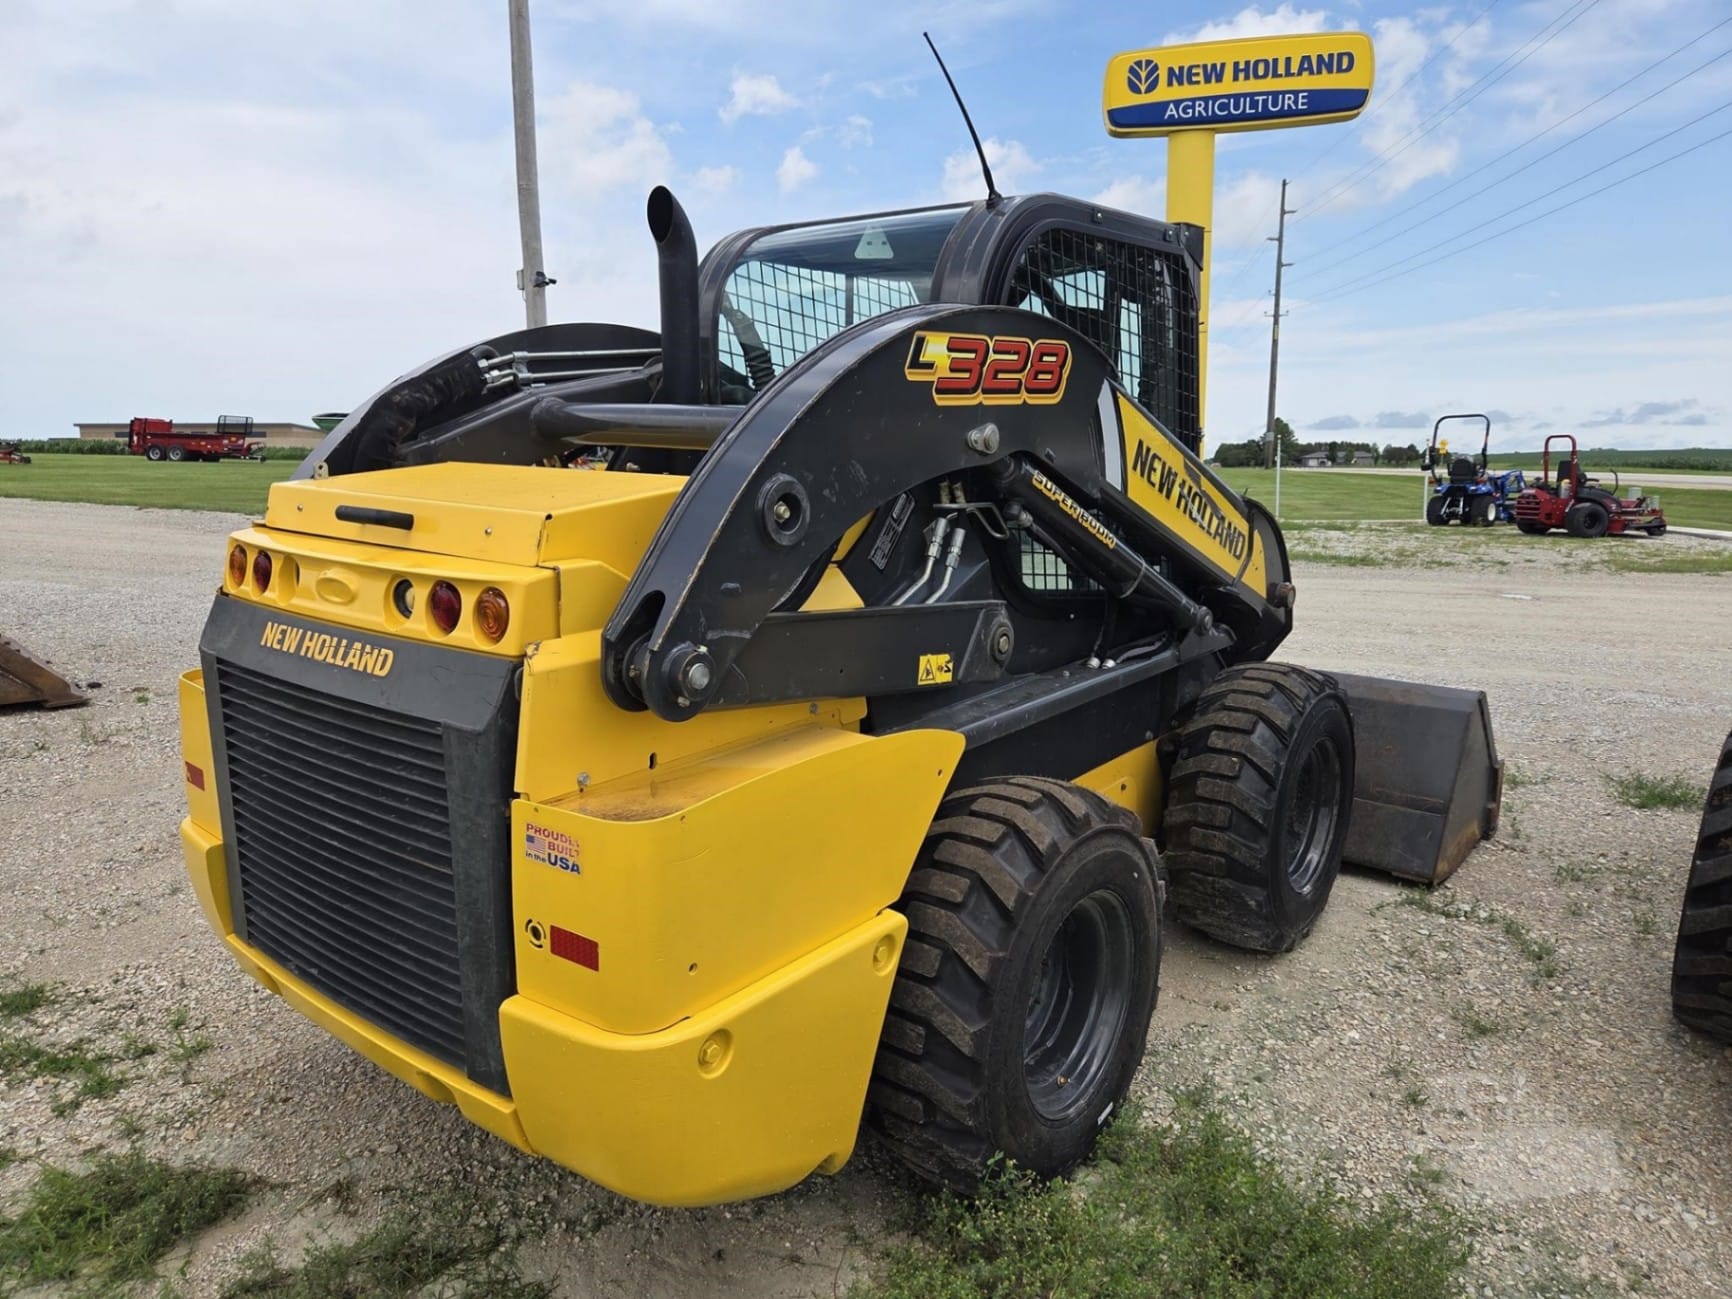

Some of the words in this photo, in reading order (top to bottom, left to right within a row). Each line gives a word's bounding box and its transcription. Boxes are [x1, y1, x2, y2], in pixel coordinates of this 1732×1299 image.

[1166, 62, 1226, 87] NEW
[1232, 51, 1355, 82] HOLLAND
[1164, 93, 1309, 120] AGRICULTURE
[906, 333, 1071, 399] L328
[1132, 438, 1178, 500] NEW
[1176, 481, 1248, 561] HOLLAND
[260, 621, 303, 654] NEW
[300, 630, 394, 678] HOLLAND
[525, 850, 533, 859] in
[533, 854, 546, 863] the
[547, 852, 581, 875] USA
